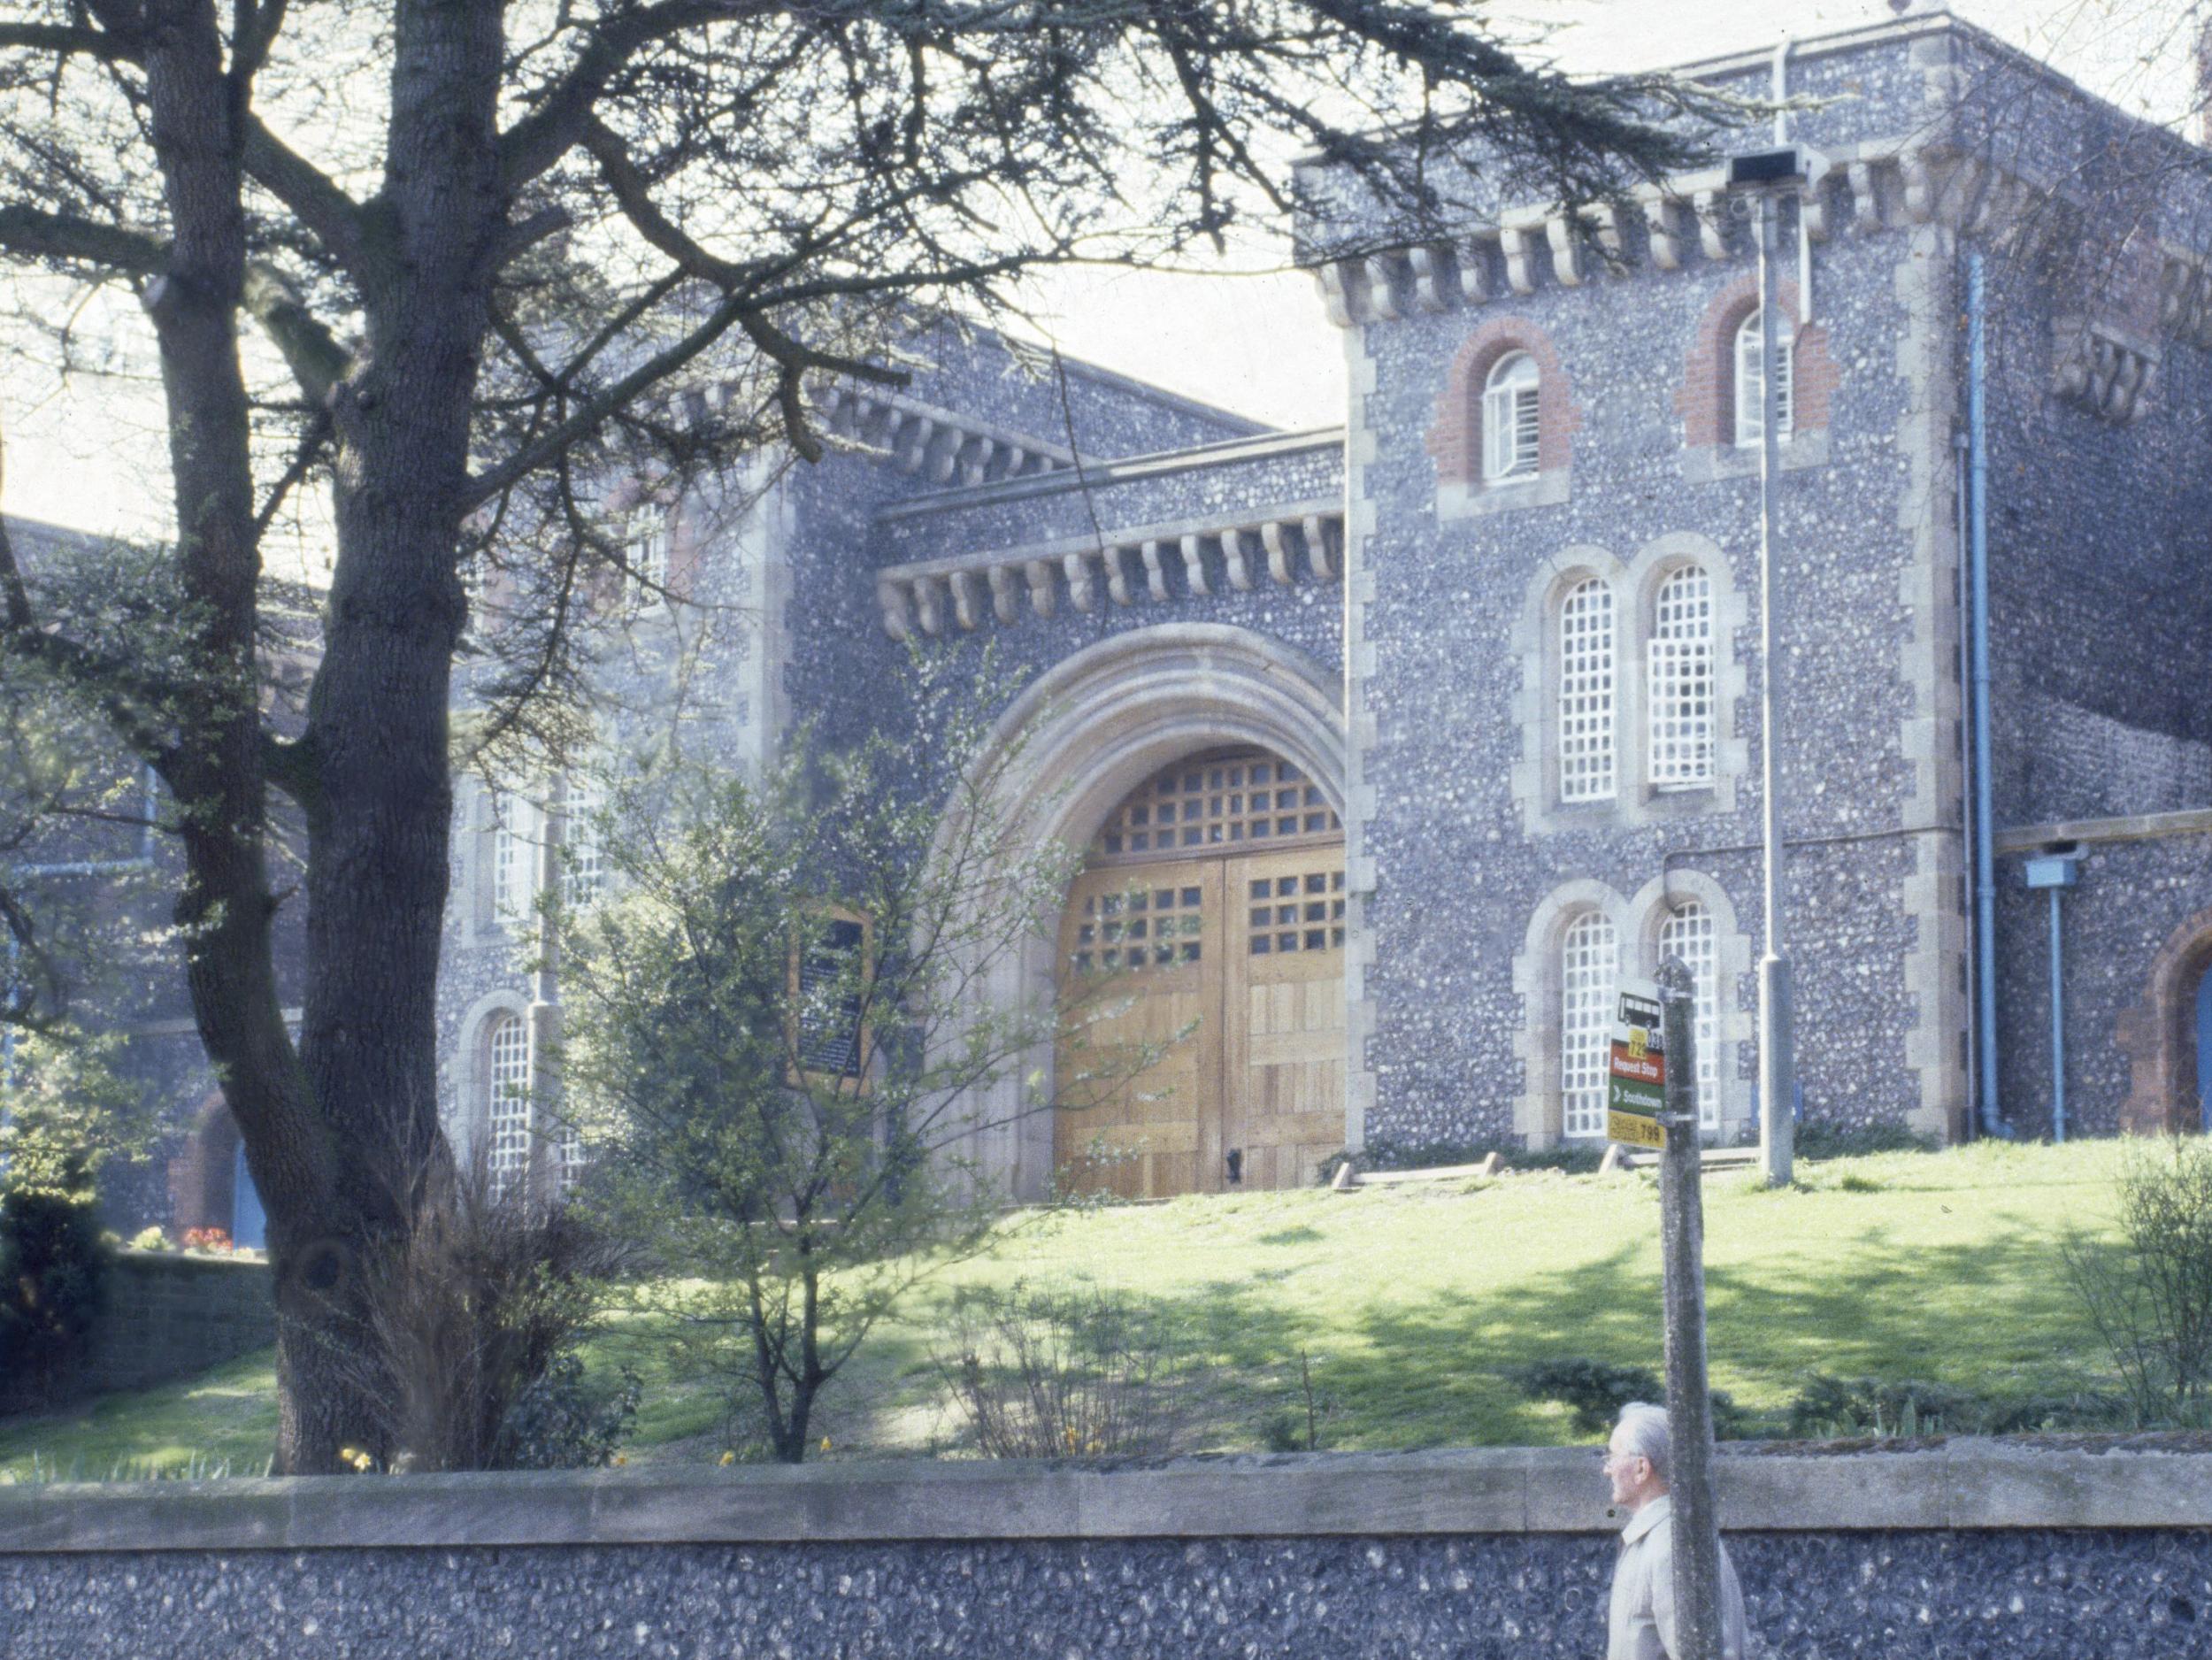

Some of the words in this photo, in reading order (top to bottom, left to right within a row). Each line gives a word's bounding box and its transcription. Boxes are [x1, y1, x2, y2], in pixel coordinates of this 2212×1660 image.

[1614, 1057, 1640, 1073] Request
[1642, 1062, 1658, 1079] Stop
[1623, 1089, 1663, 1109] Southdown
